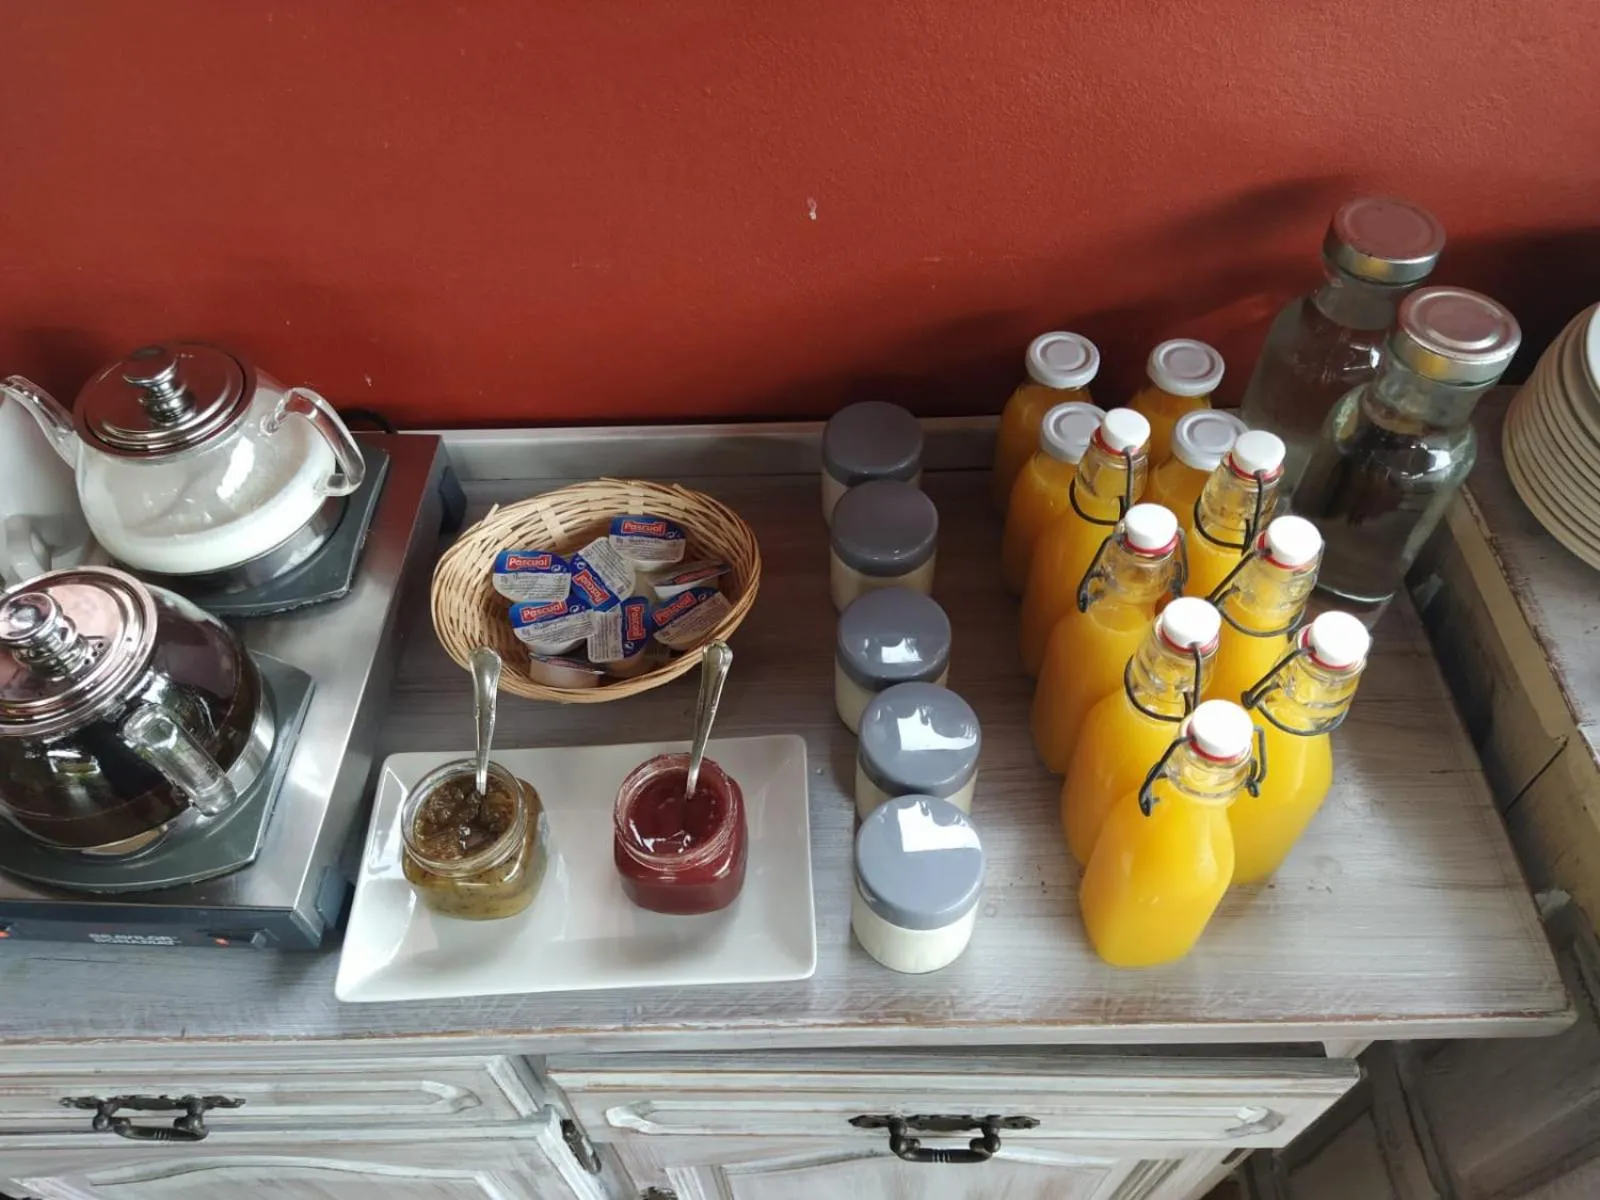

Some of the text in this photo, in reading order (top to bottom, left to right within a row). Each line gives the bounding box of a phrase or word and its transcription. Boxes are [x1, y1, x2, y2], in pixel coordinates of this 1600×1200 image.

[624, 522, 663, 533] Pascual
[508, 557, 547, 567] Pascual
[576, 574, 603, 603] Pascual
[522, 601, 564, 621] Pascual
[630, 605, 642, 637] Pascual
